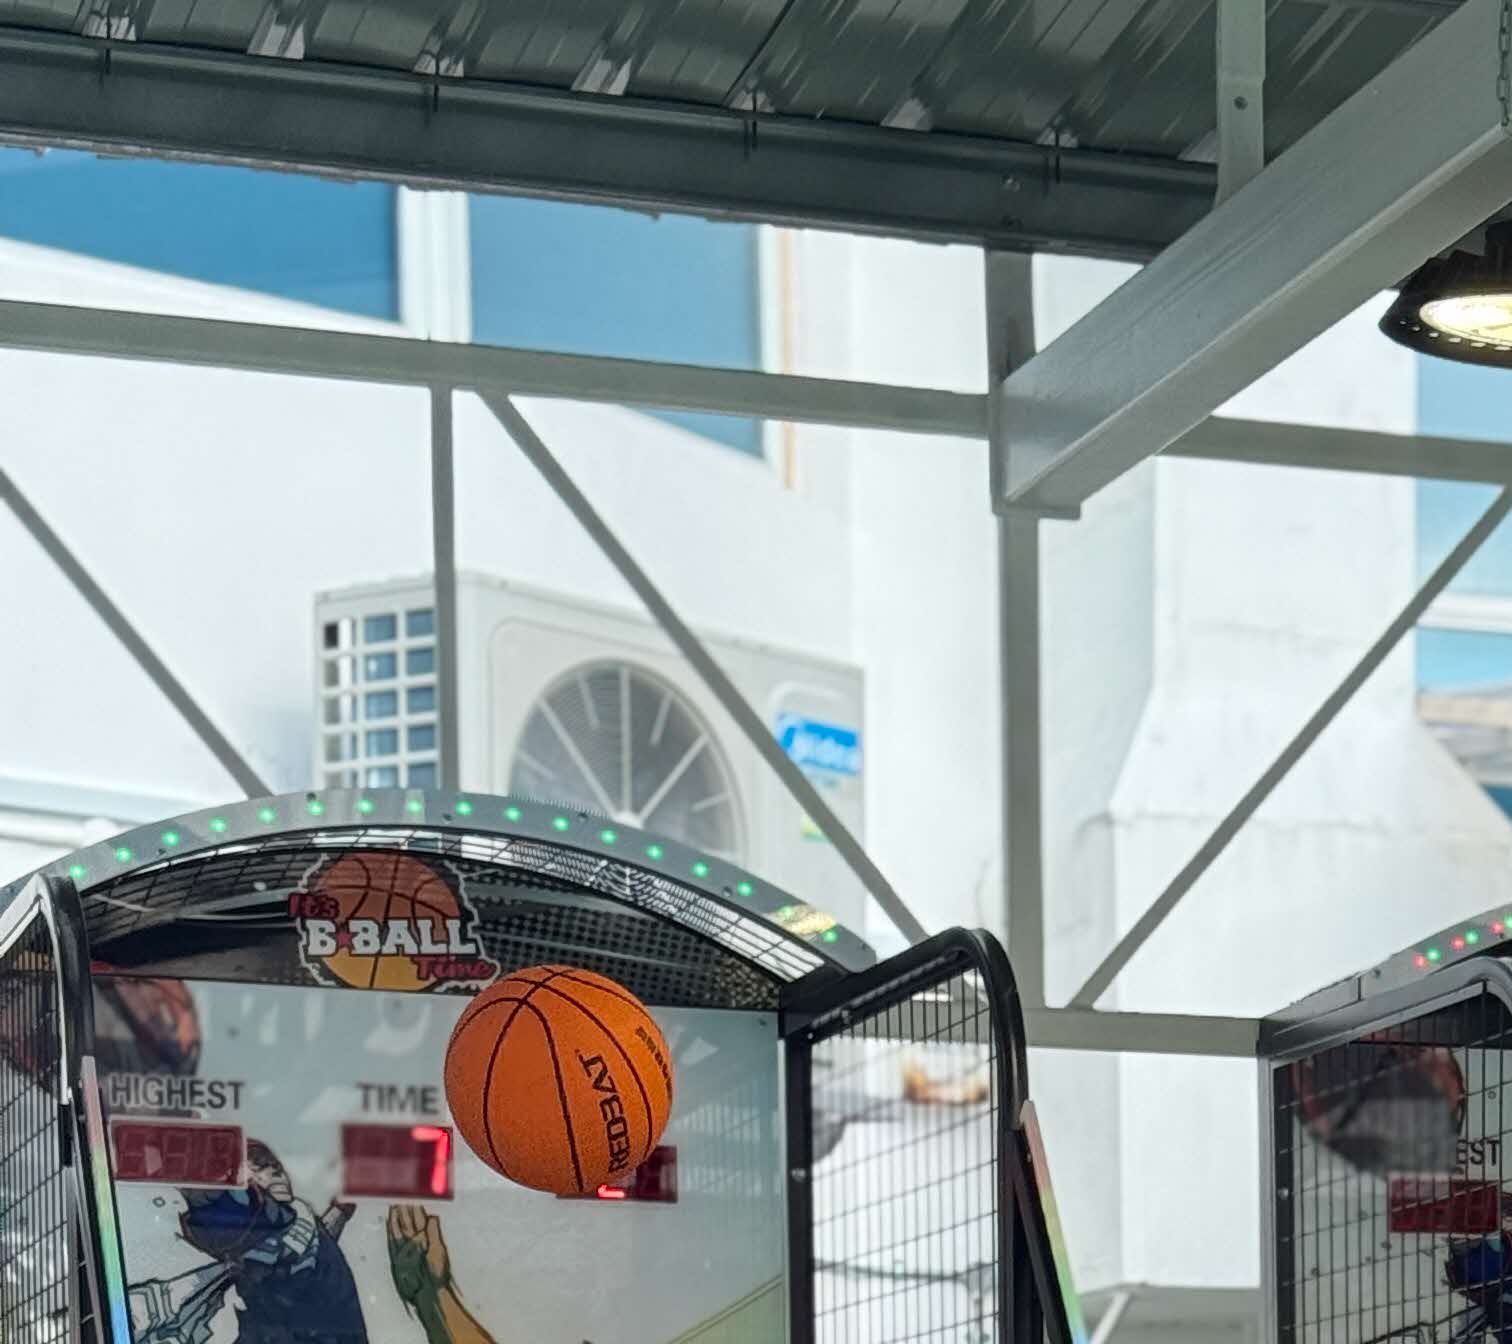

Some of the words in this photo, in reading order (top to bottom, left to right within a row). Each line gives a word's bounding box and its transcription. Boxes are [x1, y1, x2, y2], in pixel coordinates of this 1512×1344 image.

[412, 957, 499, 980] Time
[110, 1078, 245, 1110] HIGHEST
[356, 1083, 439, 1114] TIME
